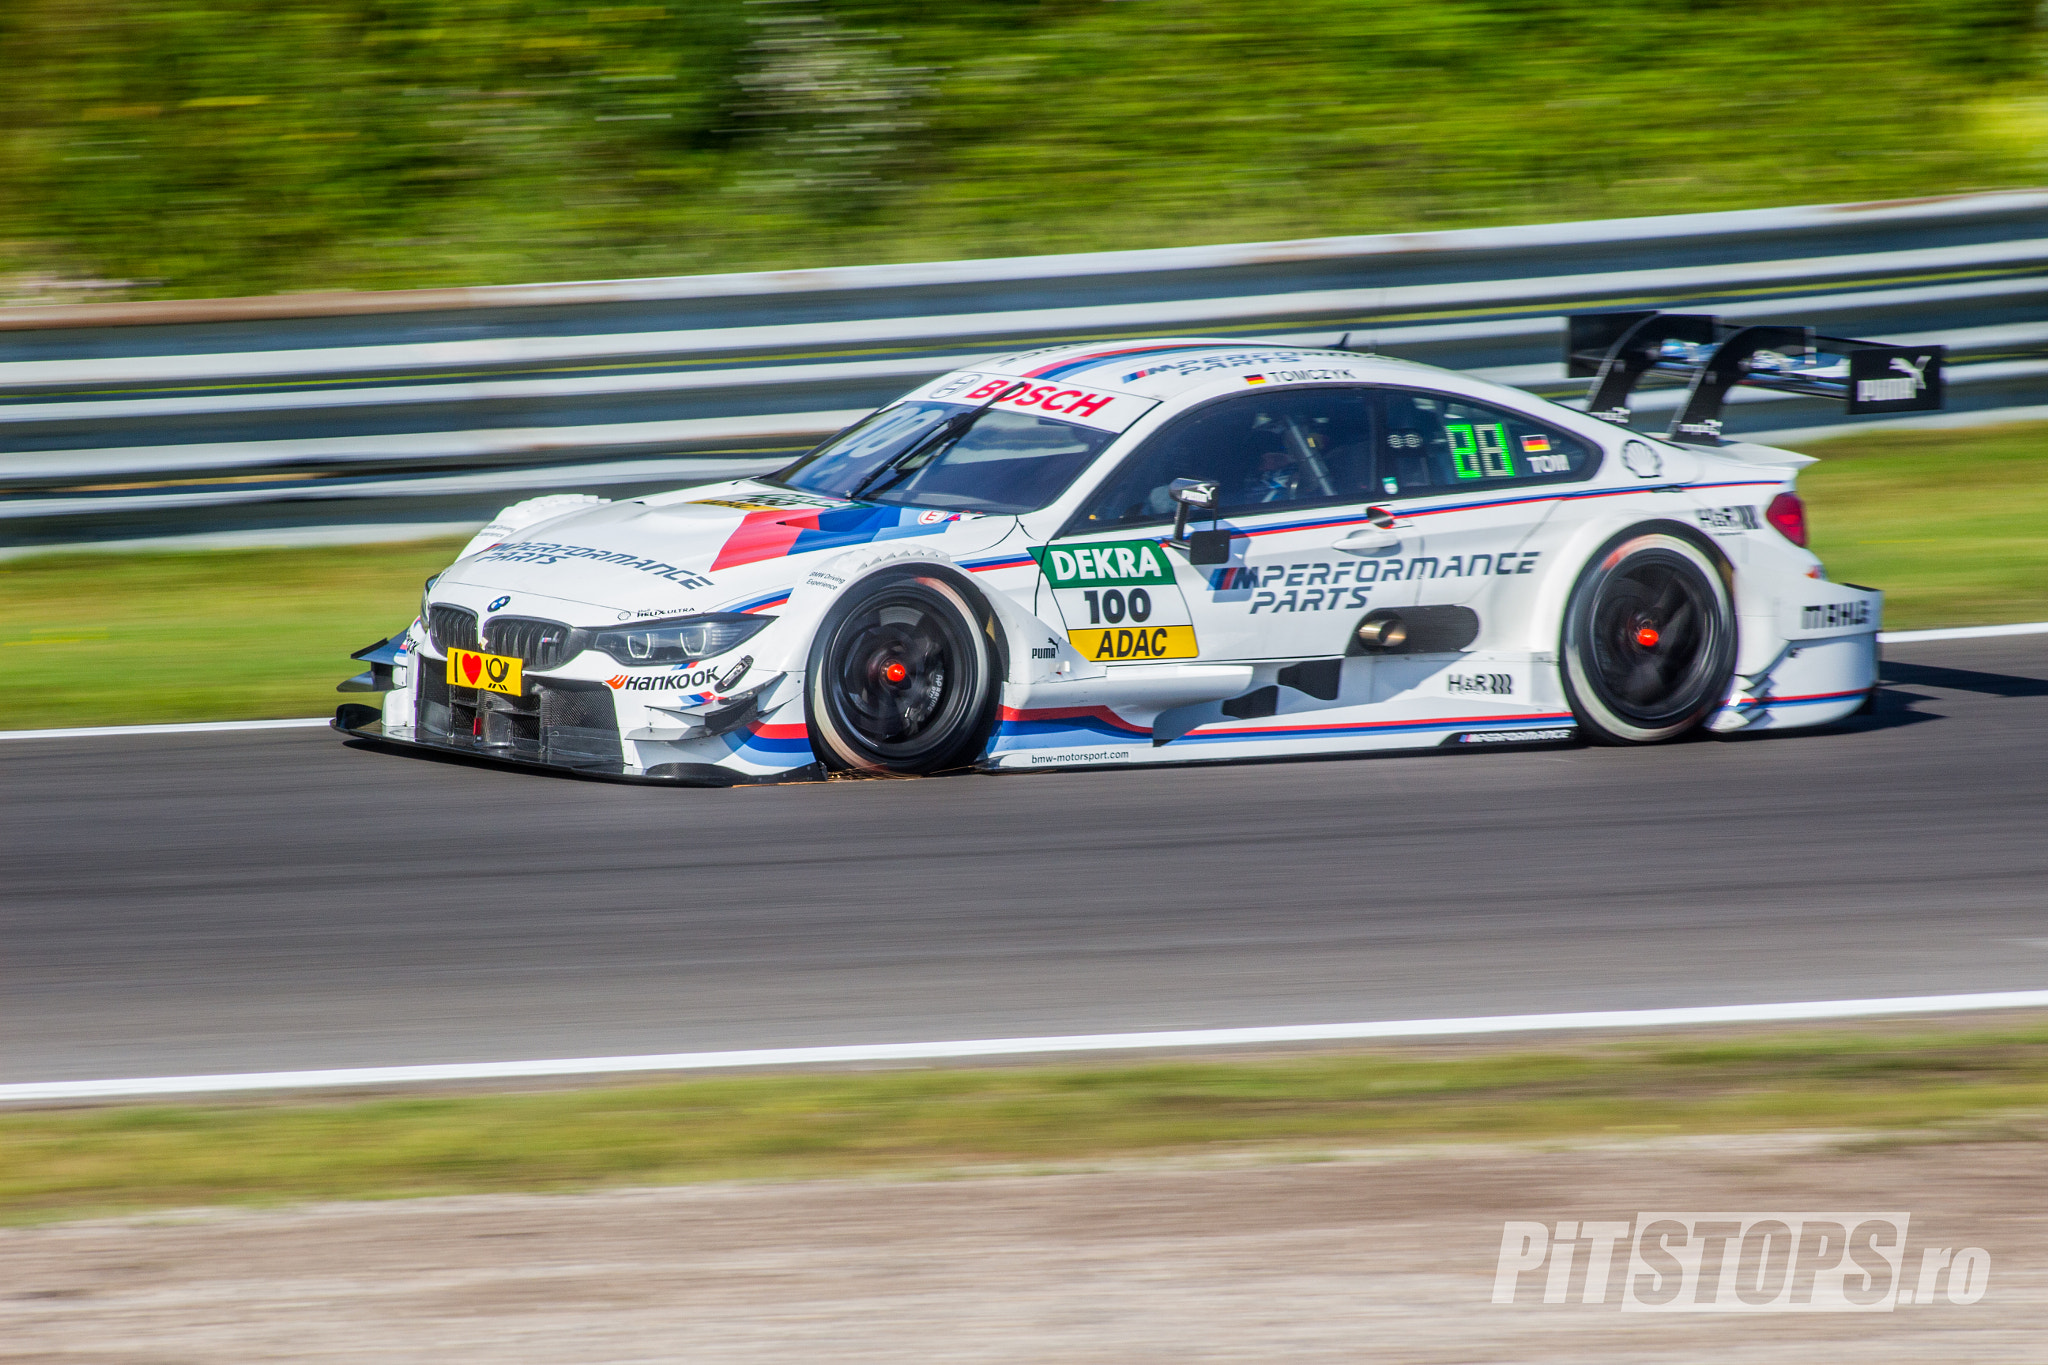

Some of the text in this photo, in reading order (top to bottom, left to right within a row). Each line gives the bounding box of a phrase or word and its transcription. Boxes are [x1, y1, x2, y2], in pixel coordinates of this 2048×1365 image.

[1180, 357, 1301, 376] PARTS
[1269, 369, 1357, 383] TOMCZYK
[965, 379, 1116, 417] BOSCH
[1526, 454, 1571, 473] TOM
[474, 552, 569, 565] PARTS
[1050, 546, 1162, 581] DEKRA
[806, 579, 838, 590] Experience
[824, 573, 846, 584] Driving
[1084, 588, 1151, 624] 100
[1249, 586, 1373, 614] PARTS
[1096, 628, 1168, 659] ADAC
[1032, 648, 1056, 659] PUMA
[1448, 673, 1487, 693] H&R
[1031, 751, 1129, 764] bmw-motorsport.com
